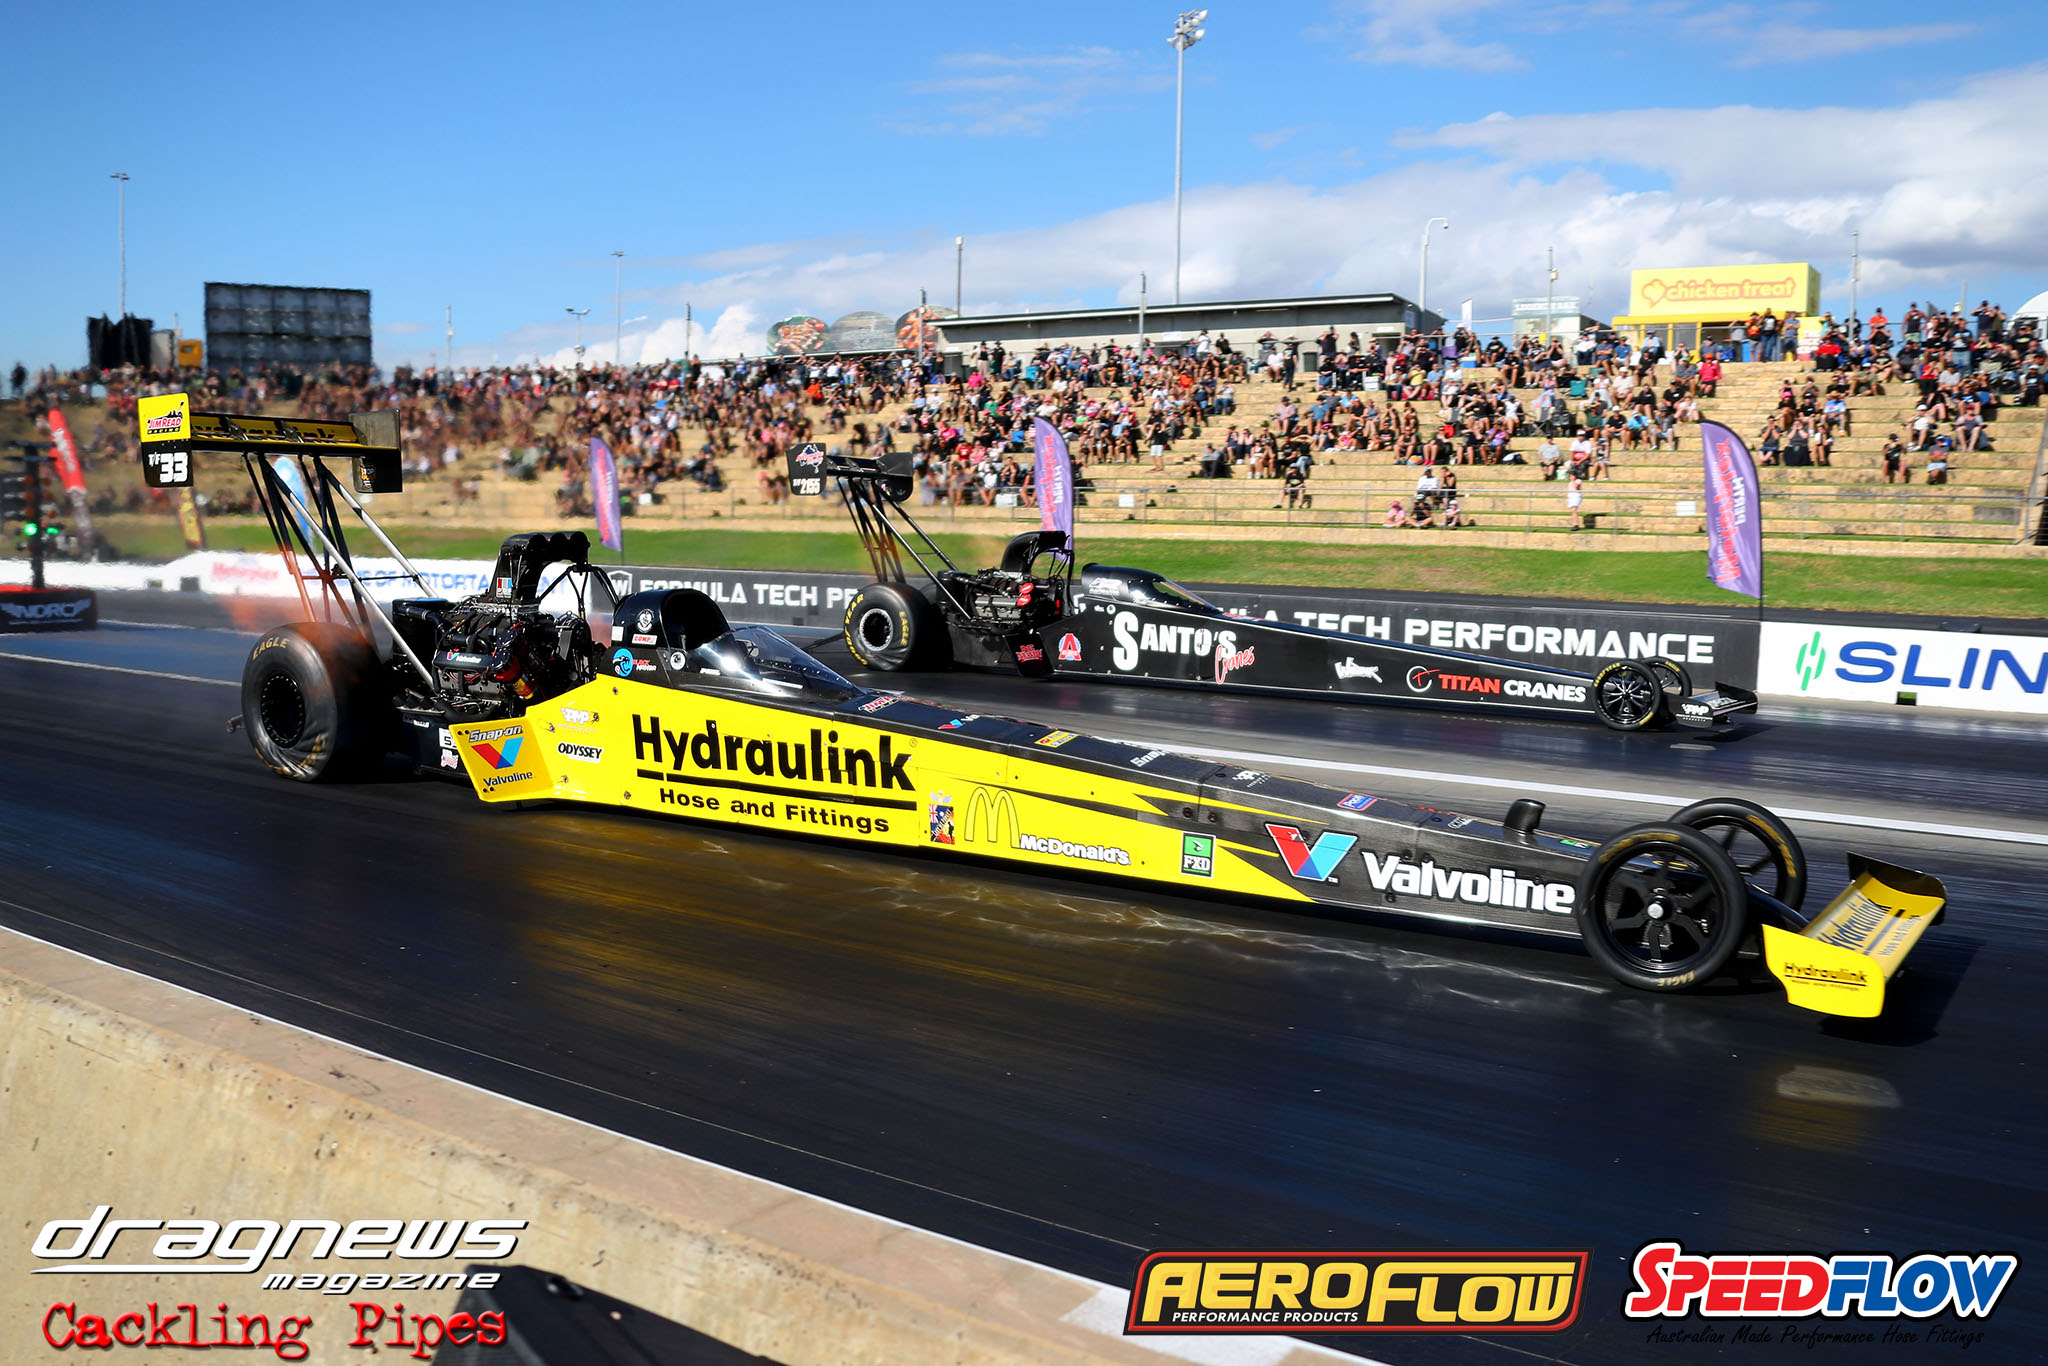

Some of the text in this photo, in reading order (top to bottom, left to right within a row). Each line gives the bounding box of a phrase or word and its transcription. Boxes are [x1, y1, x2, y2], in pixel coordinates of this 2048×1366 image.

[1667, 279, 1795, 301] chicken treat
[160, 452, 188, 483] 33
[753, 583, 818, 606] TECH
[899, 611, 910, 647] EAGLE
[1113, 611, 1237, 671] SANTO'S
[1293, 611, 1715, 663] TECH PERFORMANCE
[253, 637, 289, 660] EAGLE
[1438, 674, 1587, 702] TITAN CRANES
[469, 725, 523, 743] Snap-on
[558, 743, 602, 759] ODYSSEY
[632, 714, 916, 791] Hydraulink
[483, 771, 534, 788] Valvoline
[660, 788, 889, 834] Hose and Fittings
[1020, 833, 1131, 866] McDonald's
[1184, 854, 1211, 871] FXD
[1361, 851, 1576, 914] Valvoline
[1657, 969, 1695, 987] EAGLE
[1784, 962, 1868, 982] Hydraulink
